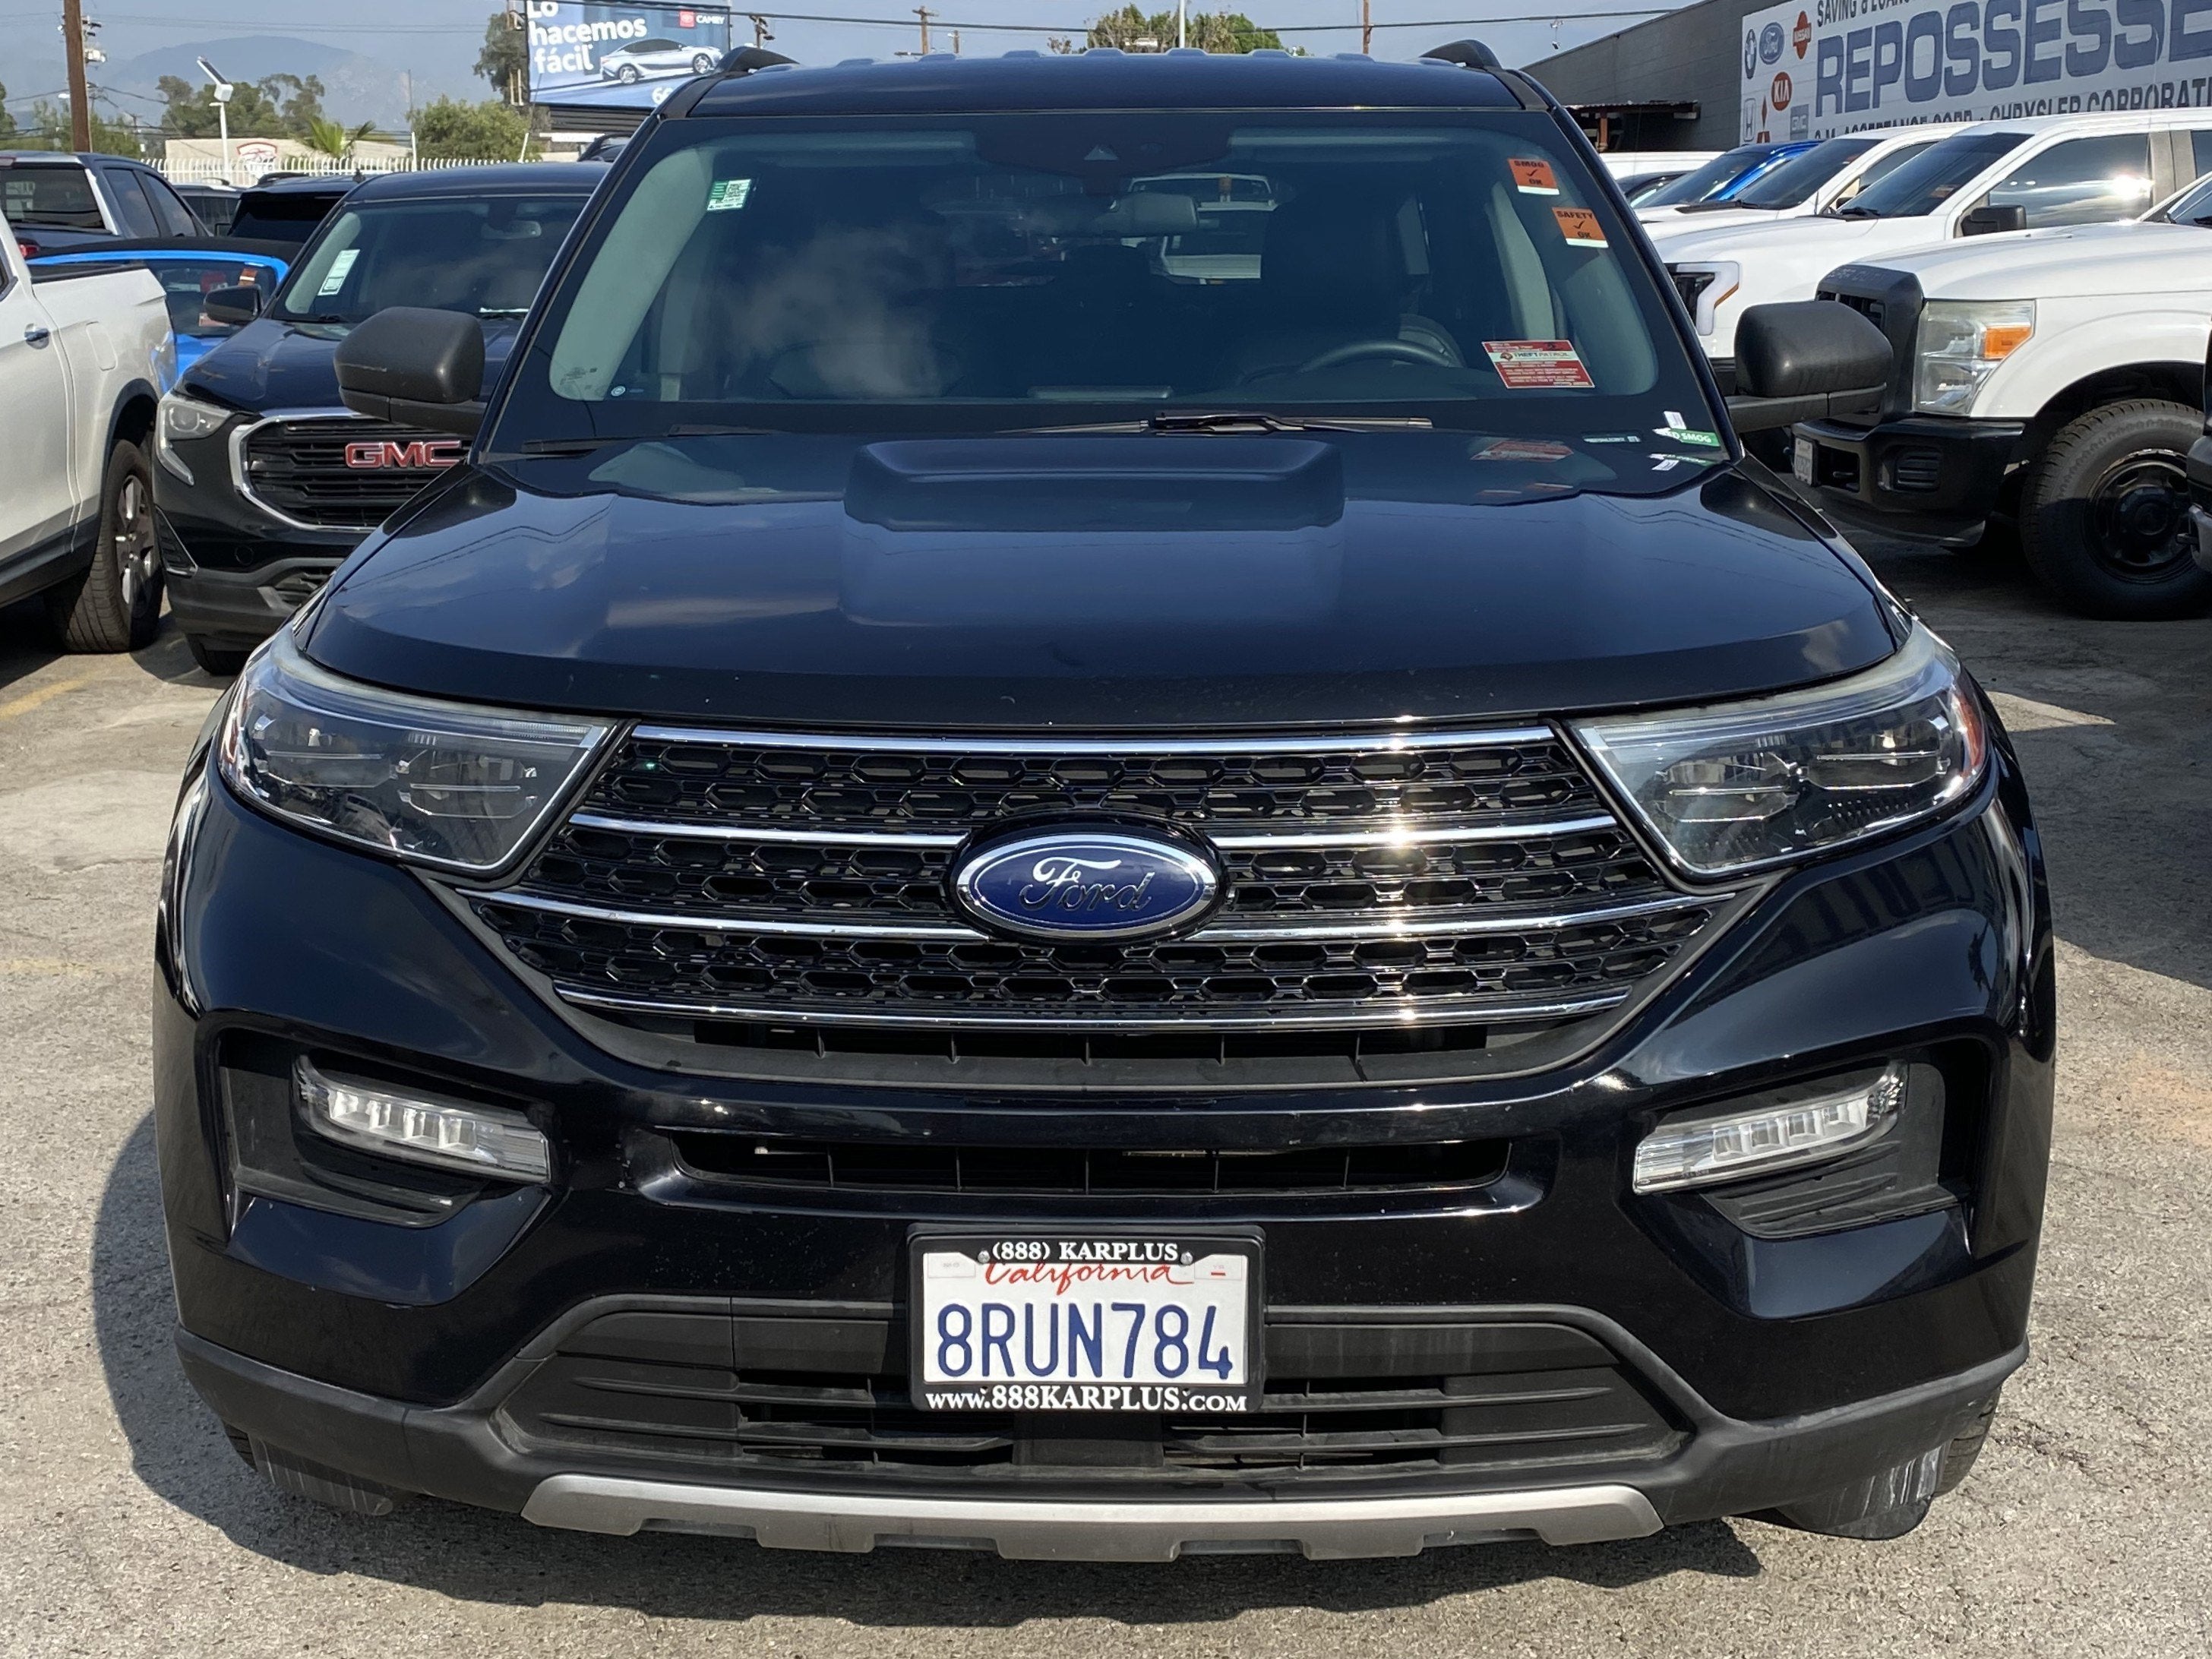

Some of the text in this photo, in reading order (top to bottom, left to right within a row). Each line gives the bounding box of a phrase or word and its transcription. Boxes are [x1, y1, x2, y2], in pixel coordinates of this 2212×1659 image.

[526, 0, 559, 18] Lo
[696, 14, 725, 24] CAMRY
[528, 18, 648, 46] hacemos
[534, 43, 594, 74] fácil
[1774, 79, 1790, 103] KIA
[1556, 210, 1593, 220] SAFETY
[1681, 432, 1712, 443] SMOG
[345, 441, 462, 468] GMC
[1019, 857, 1155, 911] Ford
[992, 1241, 1178, 1262] (888) KARPLUS
[984, 1262, 1194, 1296] California
[937, 1302, 1234, 1380] 8RUN784
